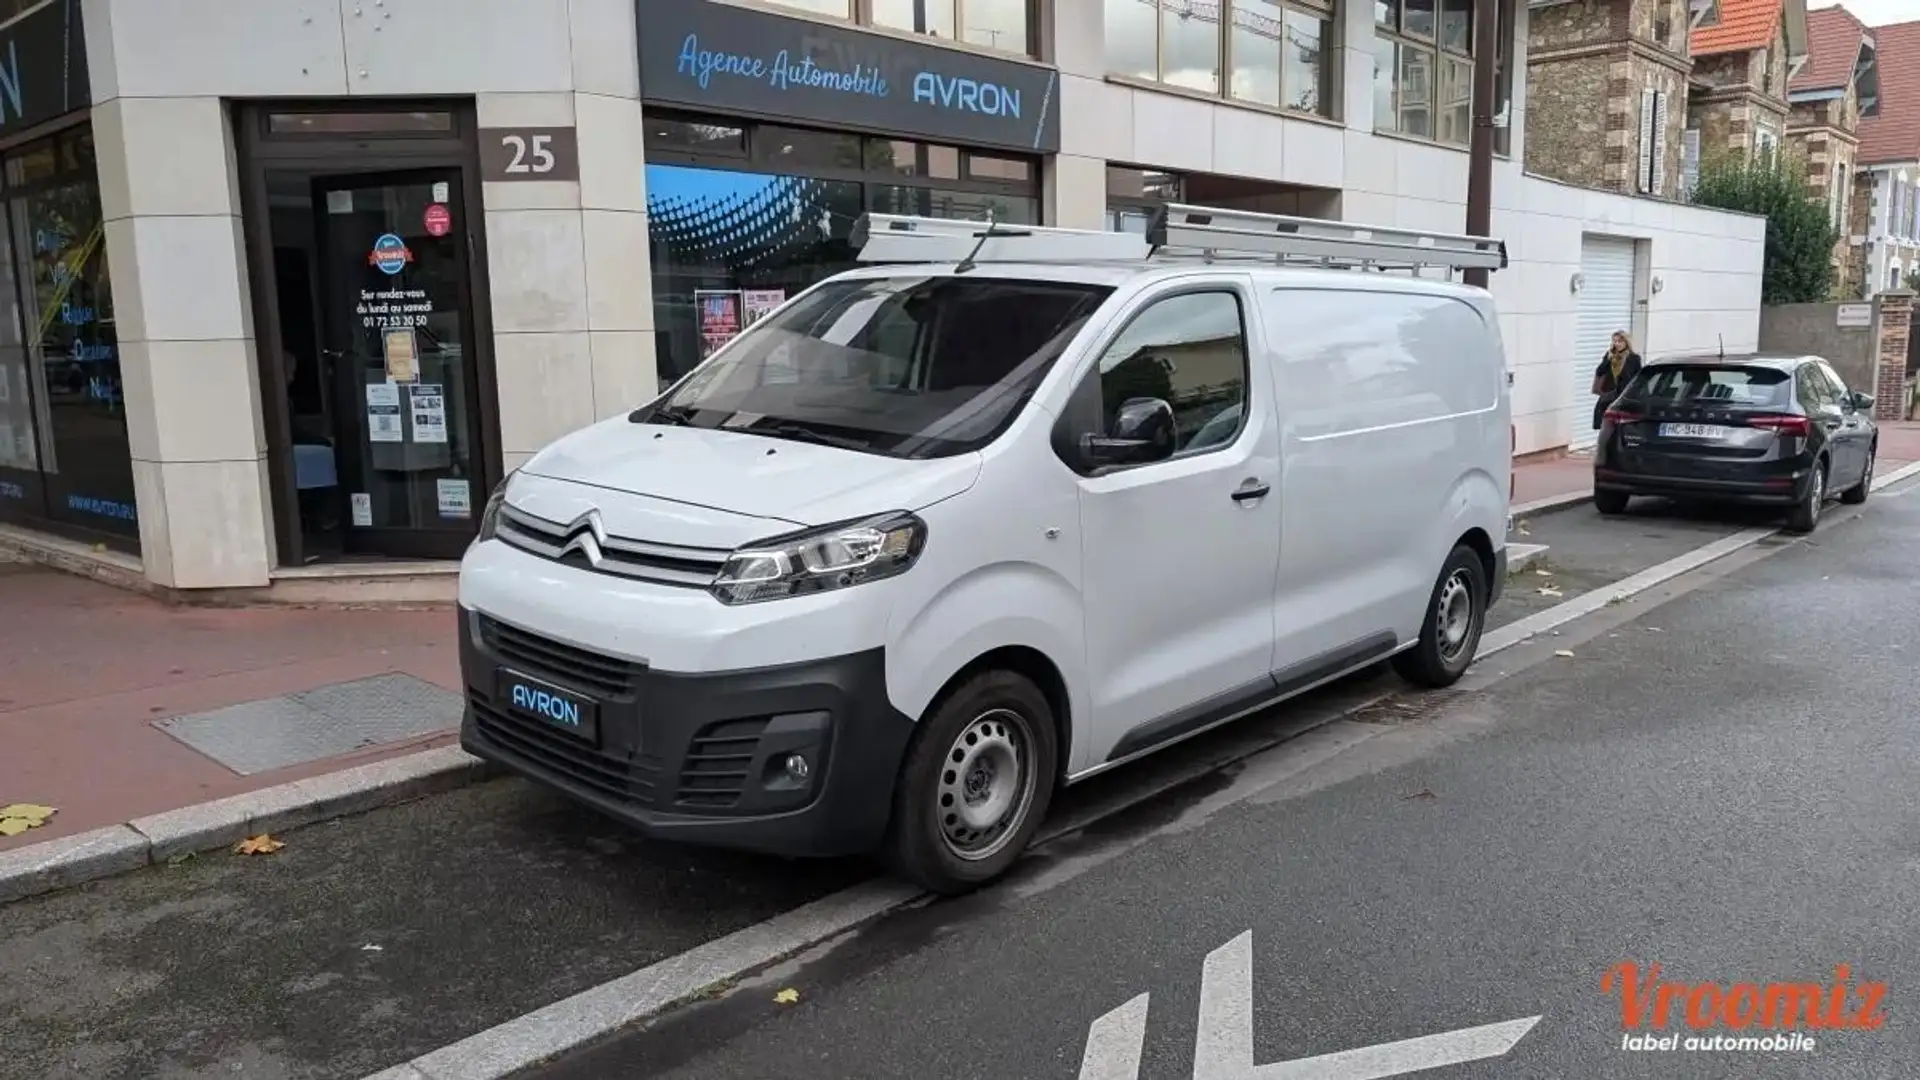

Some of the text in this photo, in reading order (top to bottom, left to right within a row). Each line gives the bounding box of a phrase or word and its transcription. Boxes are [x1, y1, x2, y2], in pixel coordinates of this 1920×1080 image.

[677, 33, 766, 89] Agence
[770, 49, 889, 98] Automobile
[913, 71, 1021, 119] AVRON
[502, 135, 555, 173] 25
[356, 300, 432, 314] du lundi au samedi
[361, 287, 425, 300] Sur rendez-vous
[363, 316, 374, 327] 01
[376, 316, 388, 326] 72
[403, 315, 414, 326] 20
[416, 315, 427, 326] 50
[512, 684, 579, 727] AVRON
